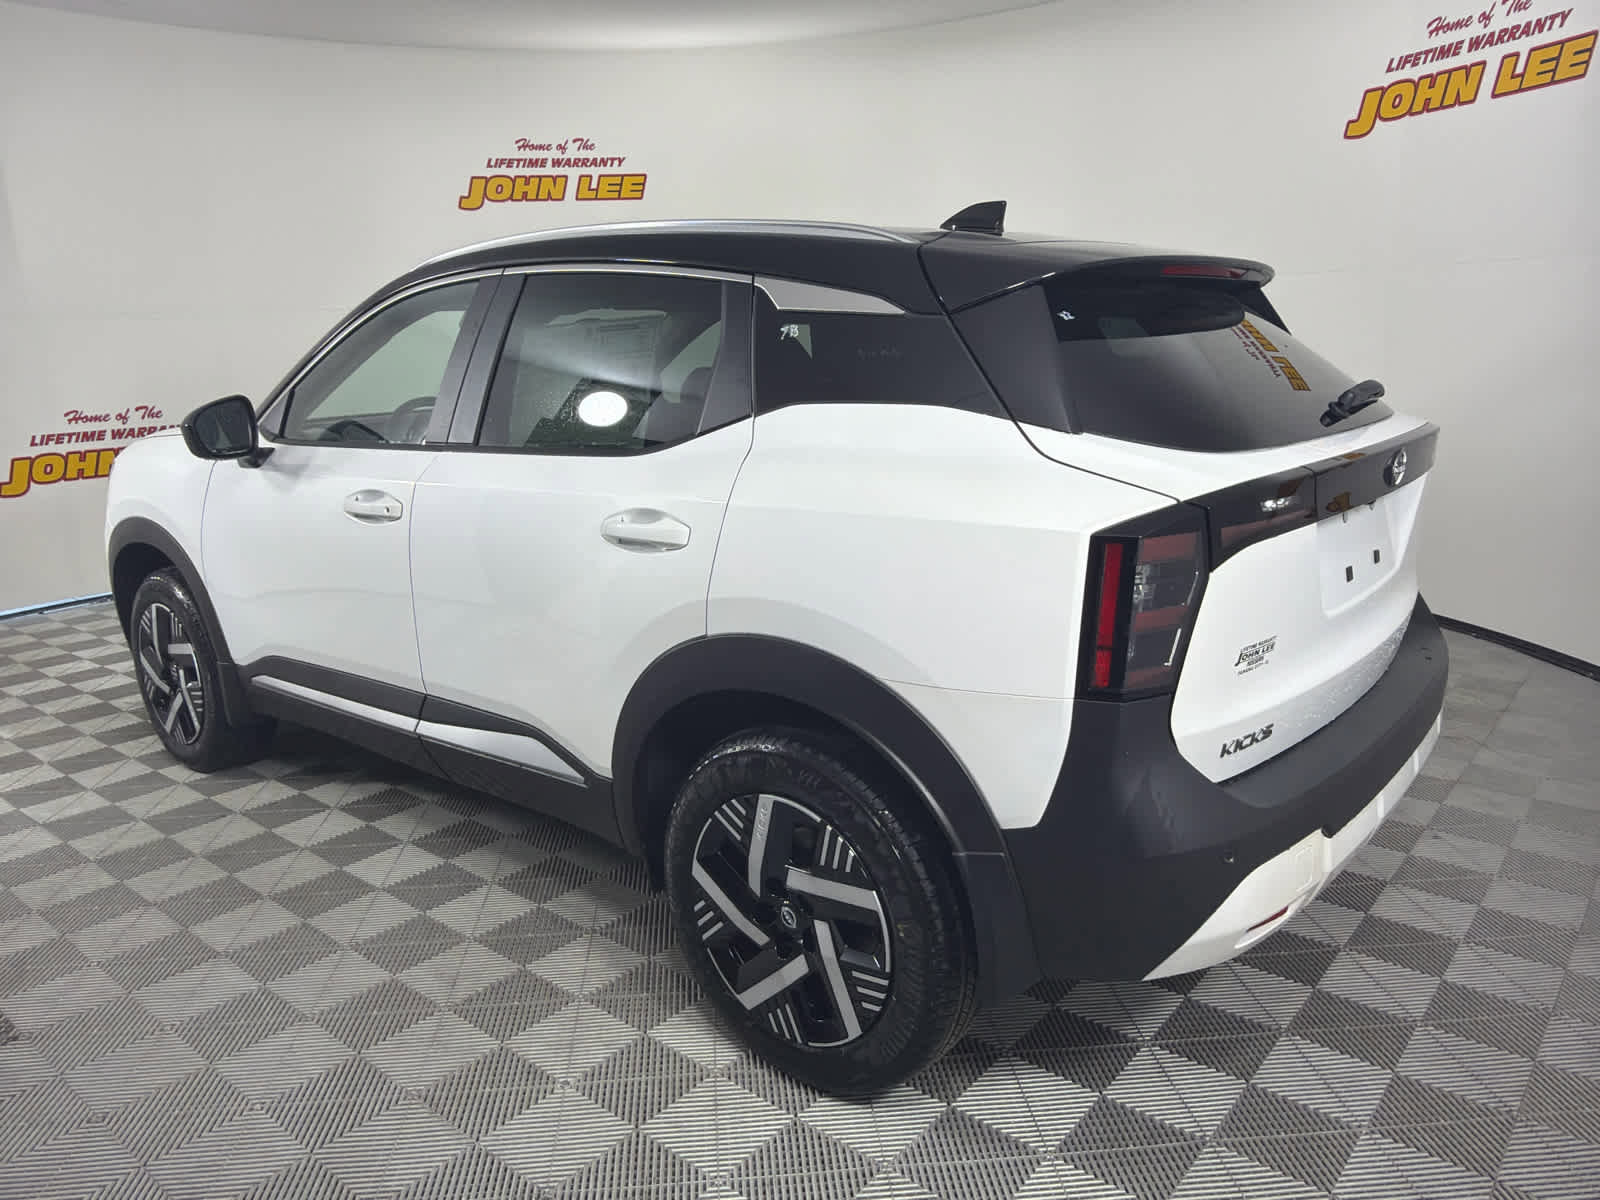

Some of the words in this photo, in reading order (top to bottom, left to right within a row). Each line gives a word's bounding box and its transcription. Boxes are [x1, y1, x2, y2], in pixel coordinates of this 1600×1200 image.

[1426, 16, 1474, 39] Home
[1477, 2, 1495, 29] of
[1501, 0, 1533, 17] The
[1385, 38, 1466, 73] LIFETIME
[1466, 8, 1574, 54] WARRANTY
[1344, 60, 1487, 140] JOHN
[1491, 29, 1599, 99] LEE
[486, 158, 548, 169] LIFETIME
[551, 157, 626, 168] WARRANTY
[515, 137, 553, 152] Home
[556, 138, 569, 155] of
[572, 137, 596, 152] The
[458, 174, 568, 211] JOHN
[576, 173, 647, 201] LEE
[63, 409, 111, 425] Home
[115, 408, 130, 425] of
[134, 405, 163, 420] The
[29, 429, 107, 447] LIFETIME
[110, 425, 181, 440] WARR
[1219, 723, 1274, 758] KICKS
